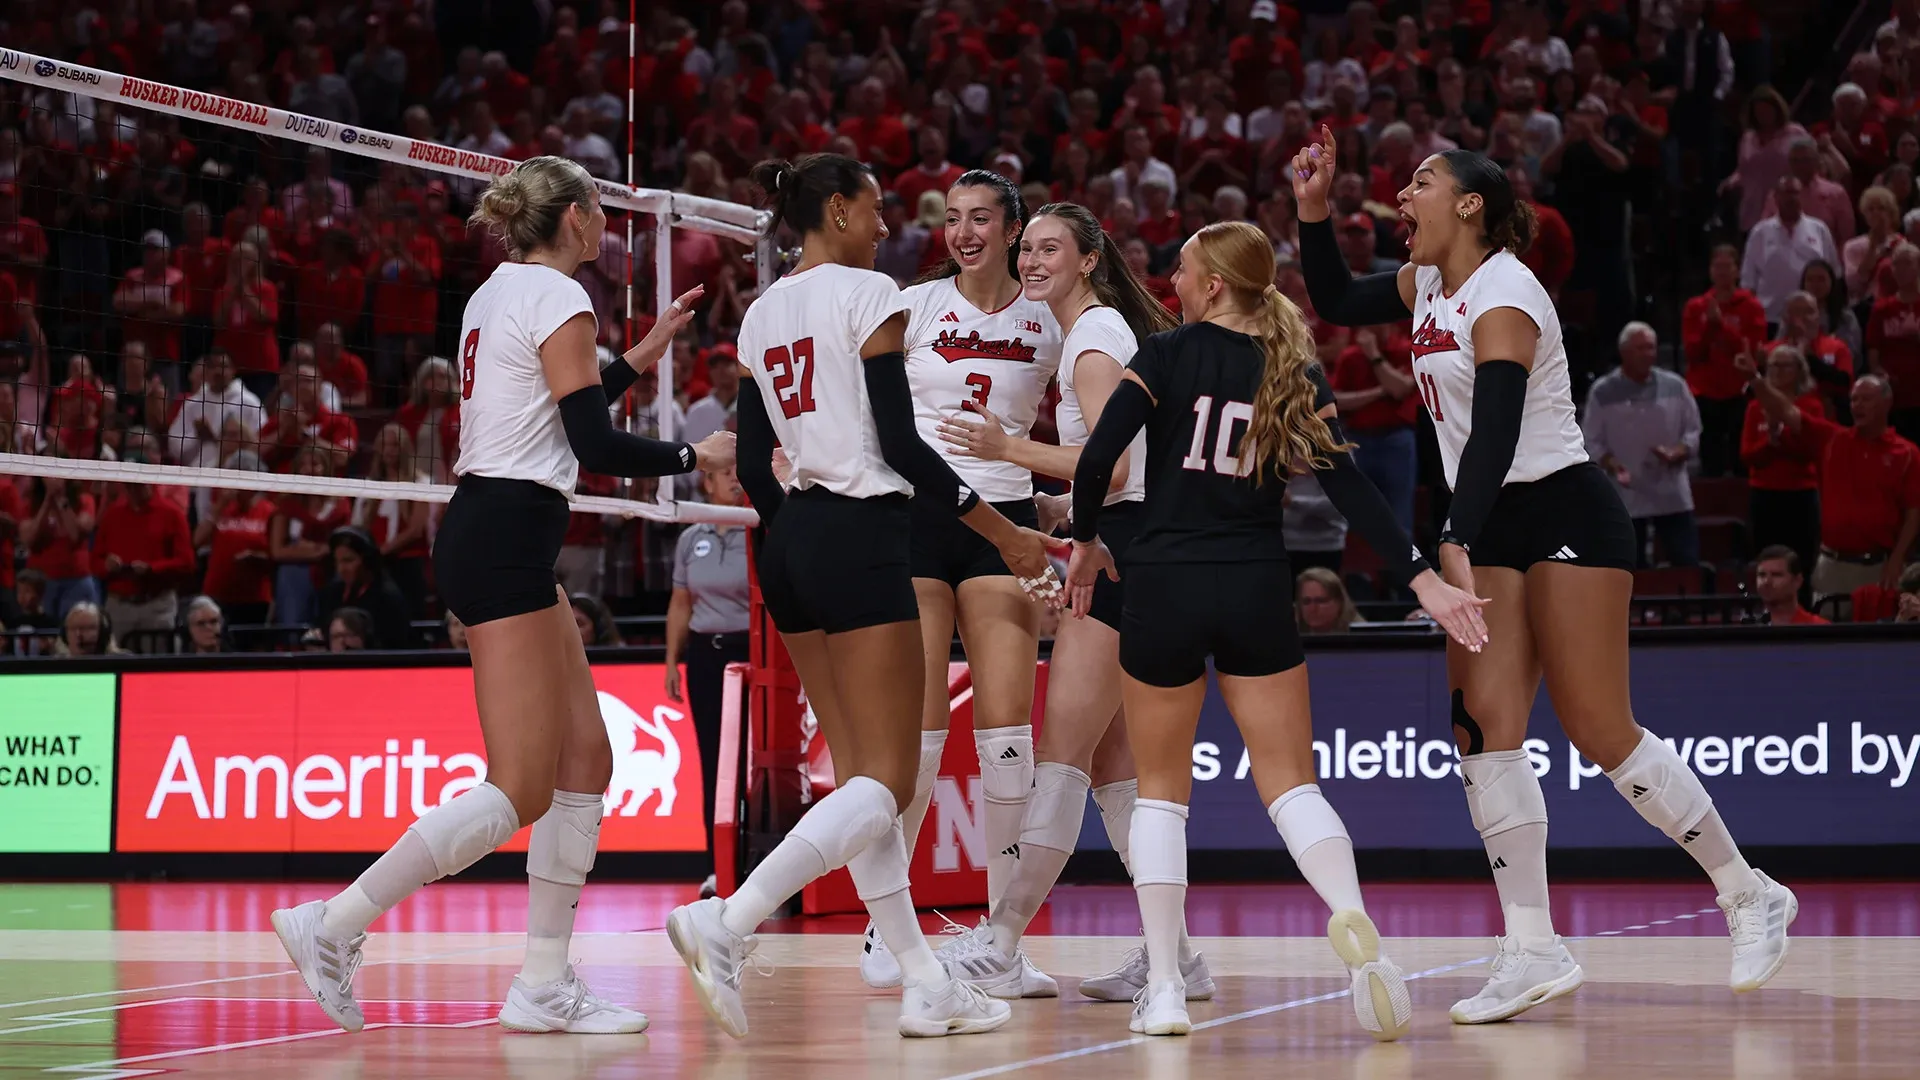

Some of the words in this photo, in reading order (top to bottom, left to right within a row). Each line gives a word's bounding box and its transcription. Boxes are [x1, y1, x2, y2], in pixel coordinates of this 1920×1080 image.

[0, 50, 20, 70] AU
[57, 66, 101, 85] SUBARU
[119, 77, 179, 107] HUSKER
[182, 90, 268, 126] VOLLEYBALL
[285, 114, 330, 138] DUTEAU
[357, 134, 394, 150] SUBARU
[408, 141, 457, 167] HUSKER
[458, 151, 516, 177] VOLLEYB
[600, 185, 632, 200] SUBARU
[931, 328, 1038, 360] Nebraska
[763, 336, 817, 420] 27
[961, 372, 992, 415] 3
[1420, 372, 1444, 422] 11
[1182, 395, 1257, 478] 10
[6, 735, 81, 756] WHAT
[1569, 722, 1829, 791] pered
[1851, 721, 1920, 788] by
[0, 766, 48, 786] CAN
[145, 734, 488, 820] Amerita
[932, 775, 988, 873] N
